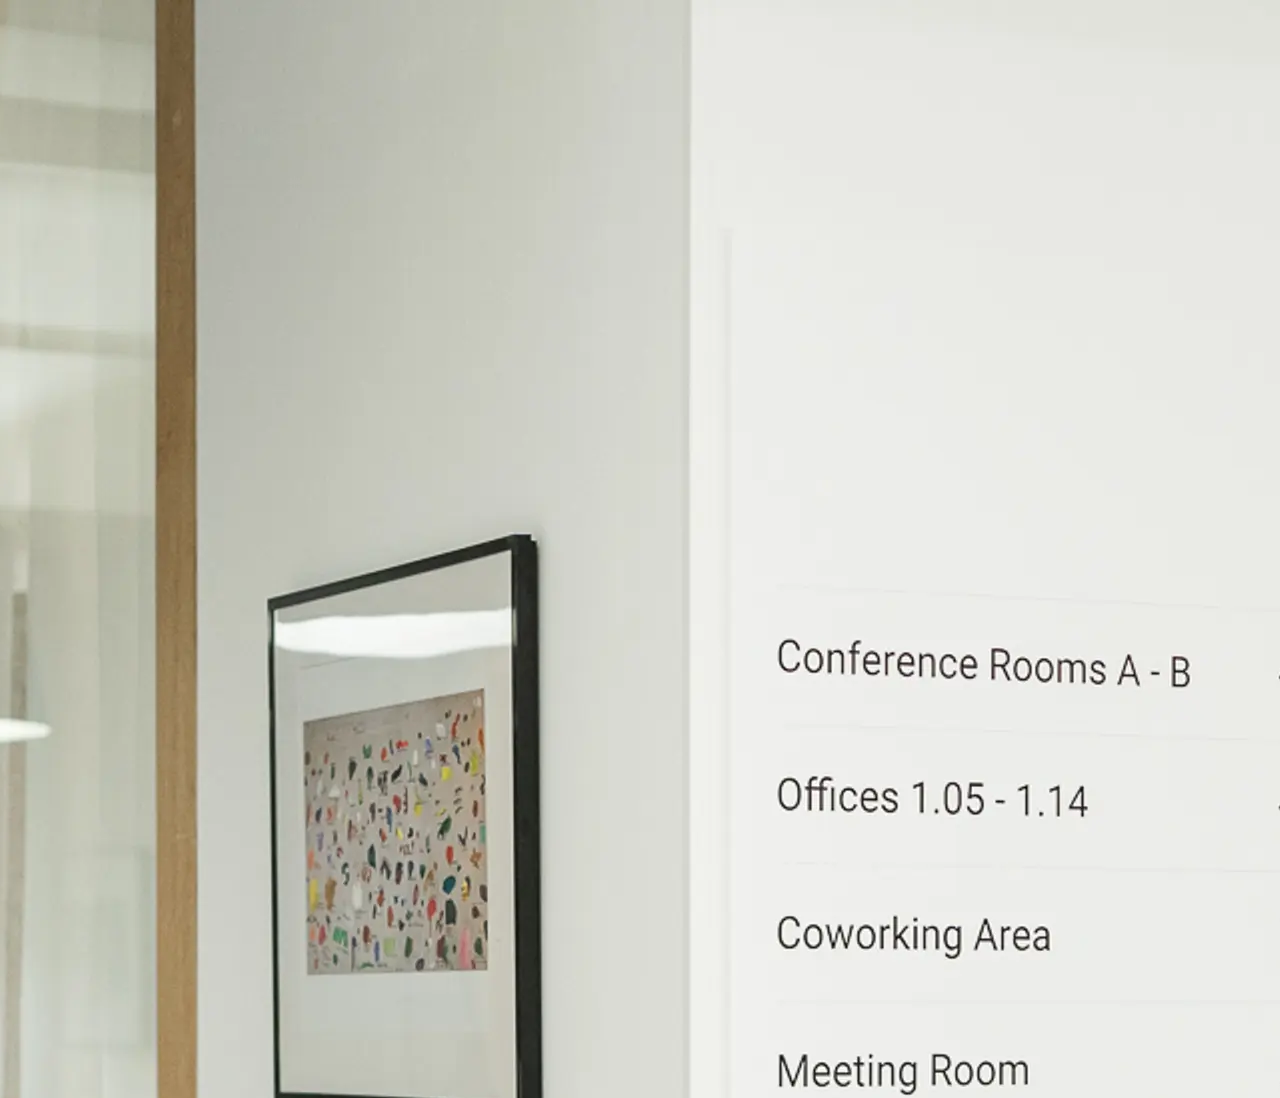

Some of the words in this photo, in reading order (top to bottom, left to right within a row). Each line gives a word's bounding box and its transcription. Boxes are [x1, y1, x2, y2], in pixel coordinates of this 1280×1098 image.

[778, 638, 979, 680] Conference
[990, 647, 1107, 686] Rooms
[1116, 653, 1141, 687] A
[1171, 655, 1191, 688] B
[777, 775, 899, 814] Offices
[912, 781, 985, 816] 1.05
[1017, 784, 1089, 818] 1.14
[777, 915, 962, 960] Coworking
[973, 917, 1051, 952] Area
[778, 1053, 918, 1096] Meeting
[931, 1053, 1029, 1087] Room
